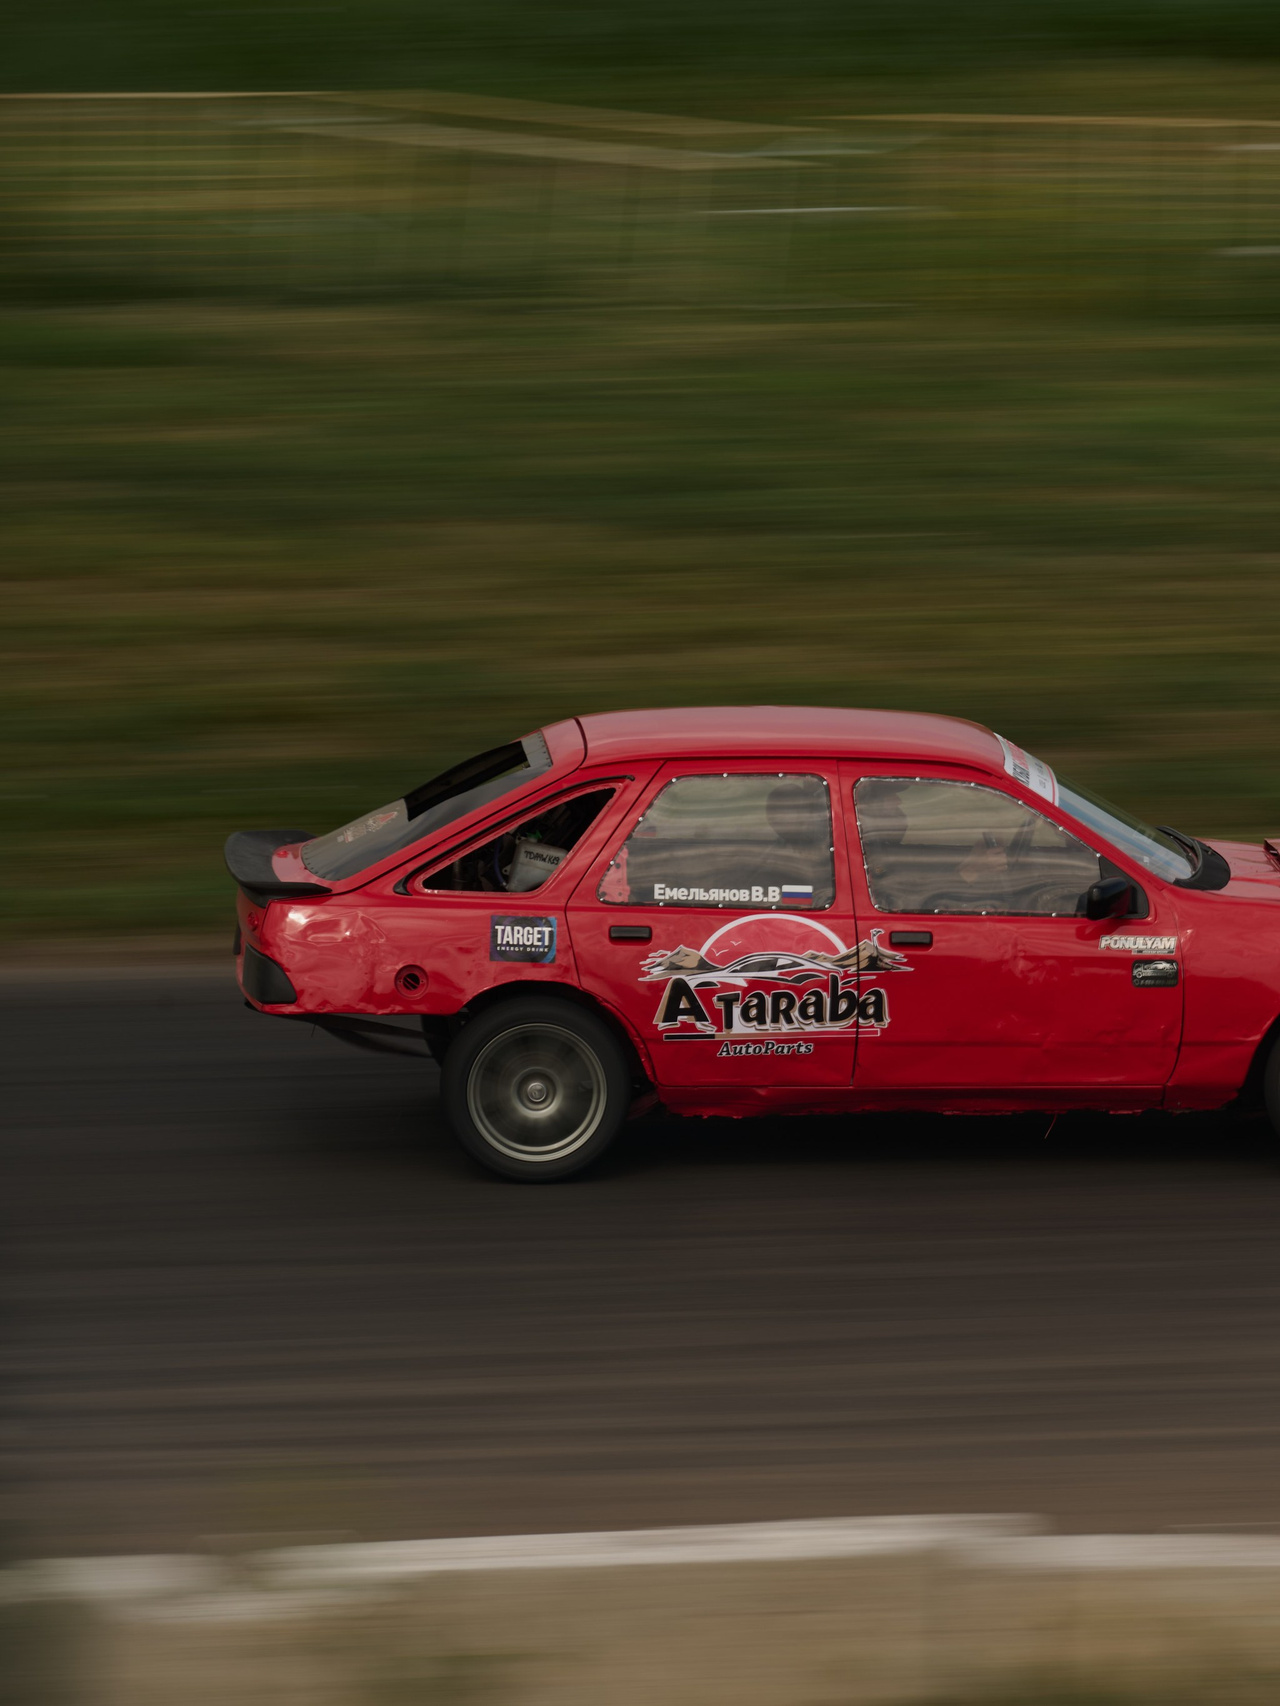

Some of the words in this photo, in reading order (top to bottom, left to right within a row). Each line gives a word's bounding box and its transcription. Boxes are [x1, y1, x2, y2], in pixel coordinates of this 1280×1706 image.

[654, 884, 749, 902] Емельянов
[494, 925, 552, 946] TARGET
[1100, 936, 1176, 949] PONULYAM
[717, 1040, 813, 1057] AutoParts
